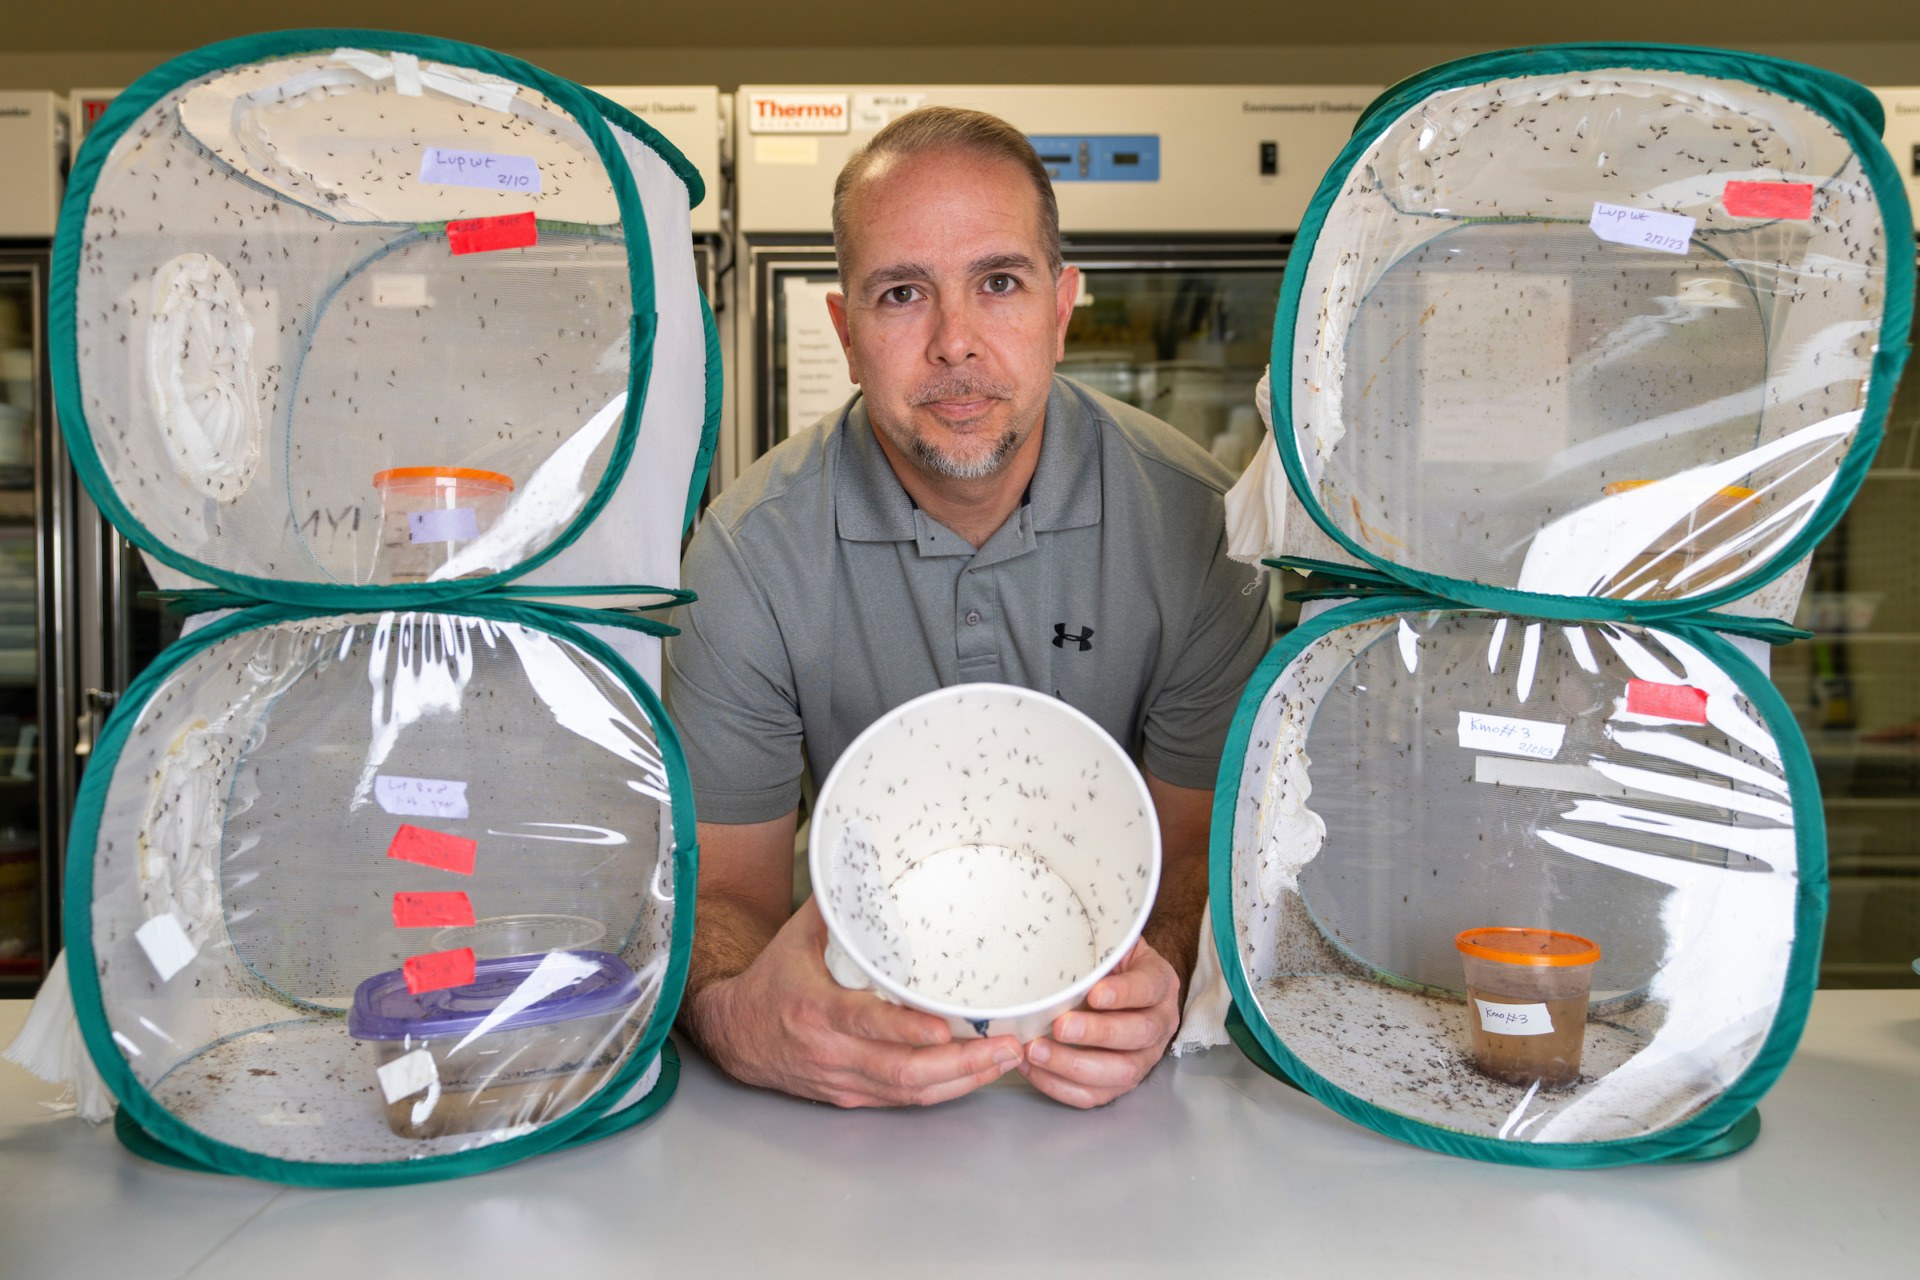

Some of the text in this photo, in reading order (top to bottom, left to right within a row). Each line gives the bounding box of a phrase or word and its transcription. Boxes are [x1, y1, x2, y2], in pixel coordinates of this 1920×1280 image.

[755, 100, 843, 118] Thermo
[498, 174, 529, 187] 2/10
[1644, 232, 1684, 250] 2/2/23
